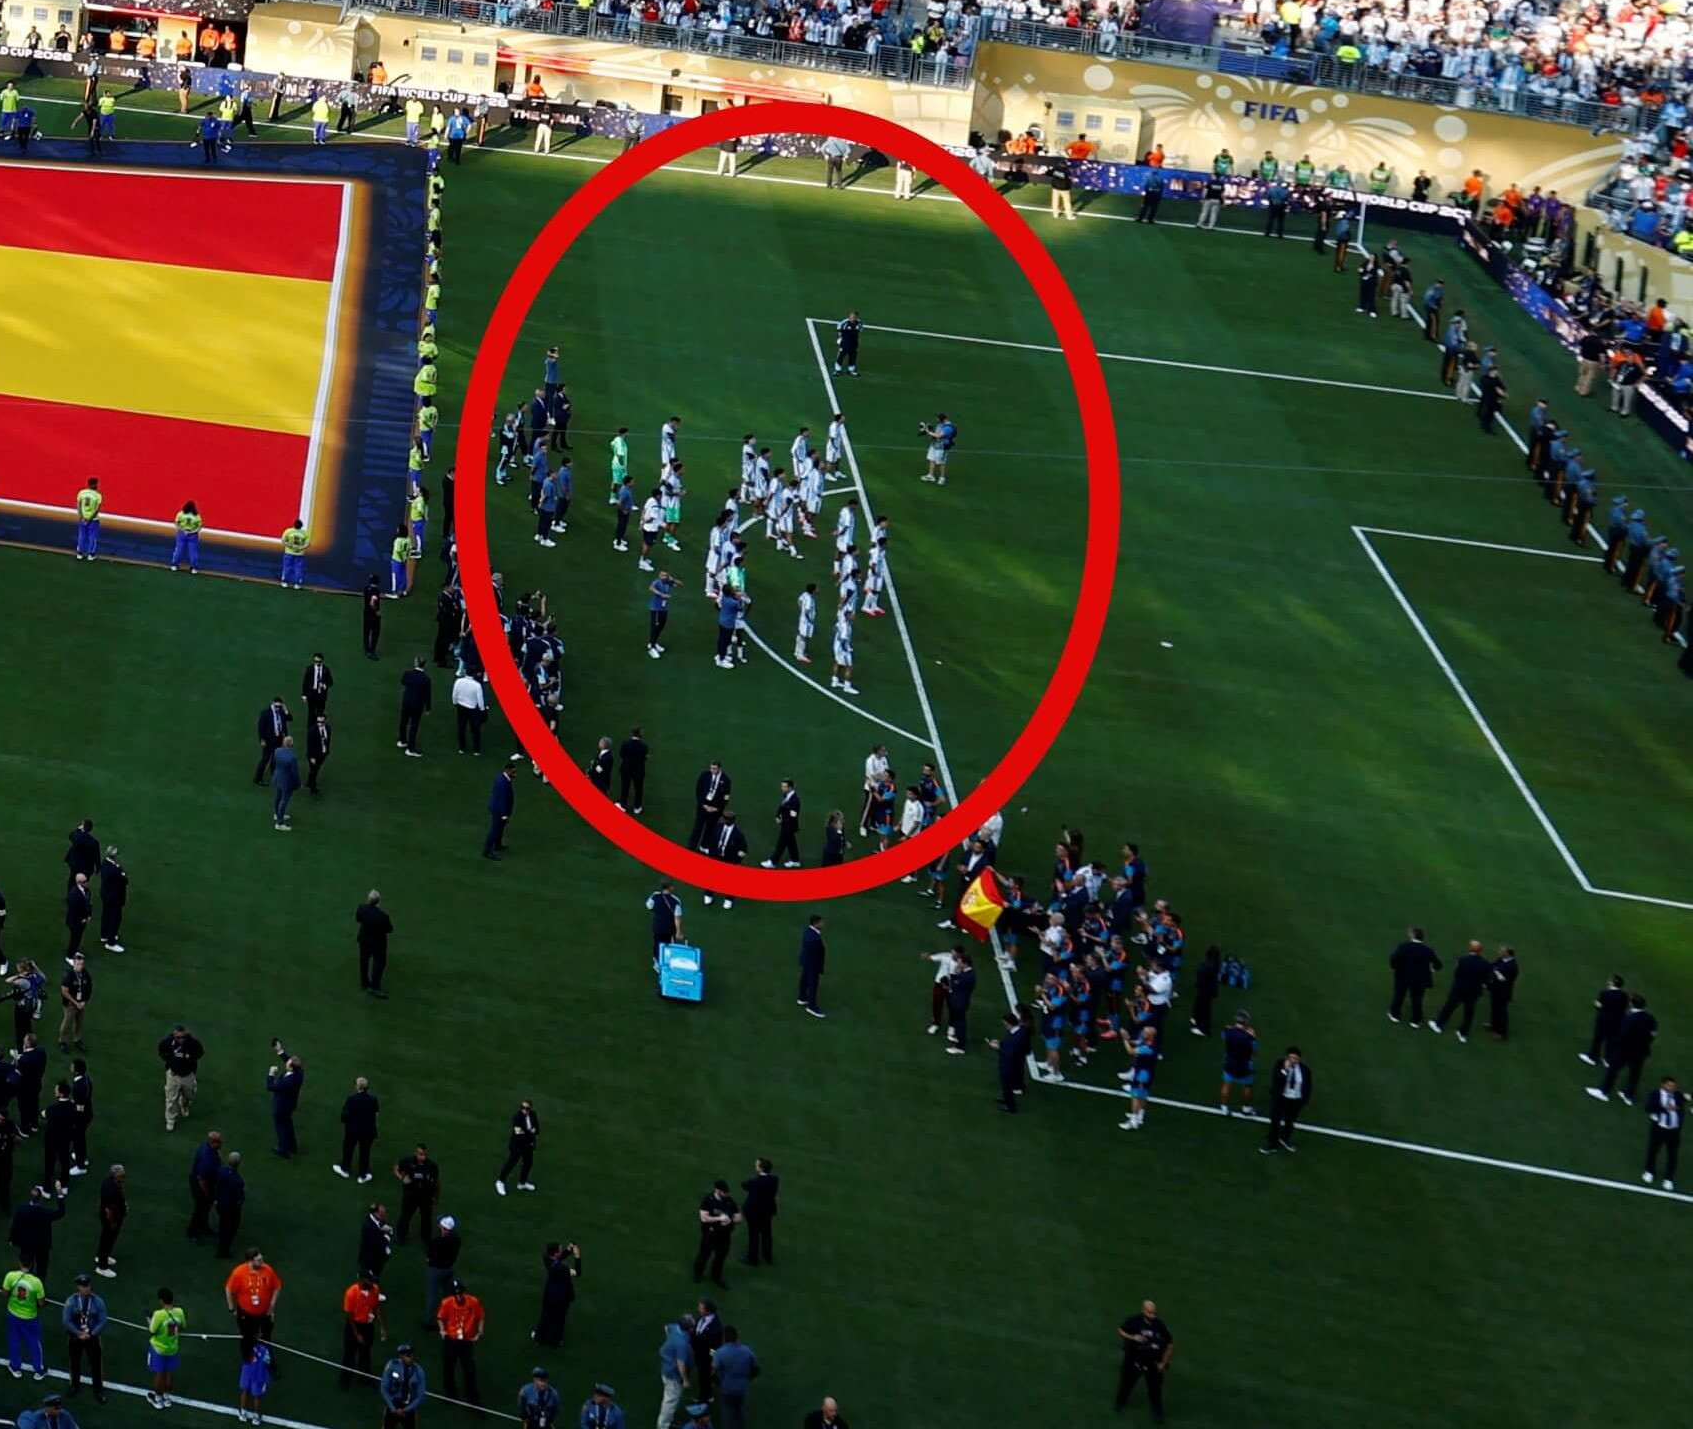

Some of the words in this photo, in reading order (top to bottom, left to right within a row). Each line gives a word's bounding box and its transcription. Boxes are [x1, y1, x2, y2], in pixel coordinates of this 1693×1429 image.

[9, 47, 33, 57] CUP
[33, 51, 72, 62] 2026
[395, 87, 441, 100] WORLD
[441, 91, 466, 103] CUP
[1244, 101, 1300, 124] FIFA
[1356, 192, 1408, 209] WORLD
[1408, 200, 1439, 214] CUP
